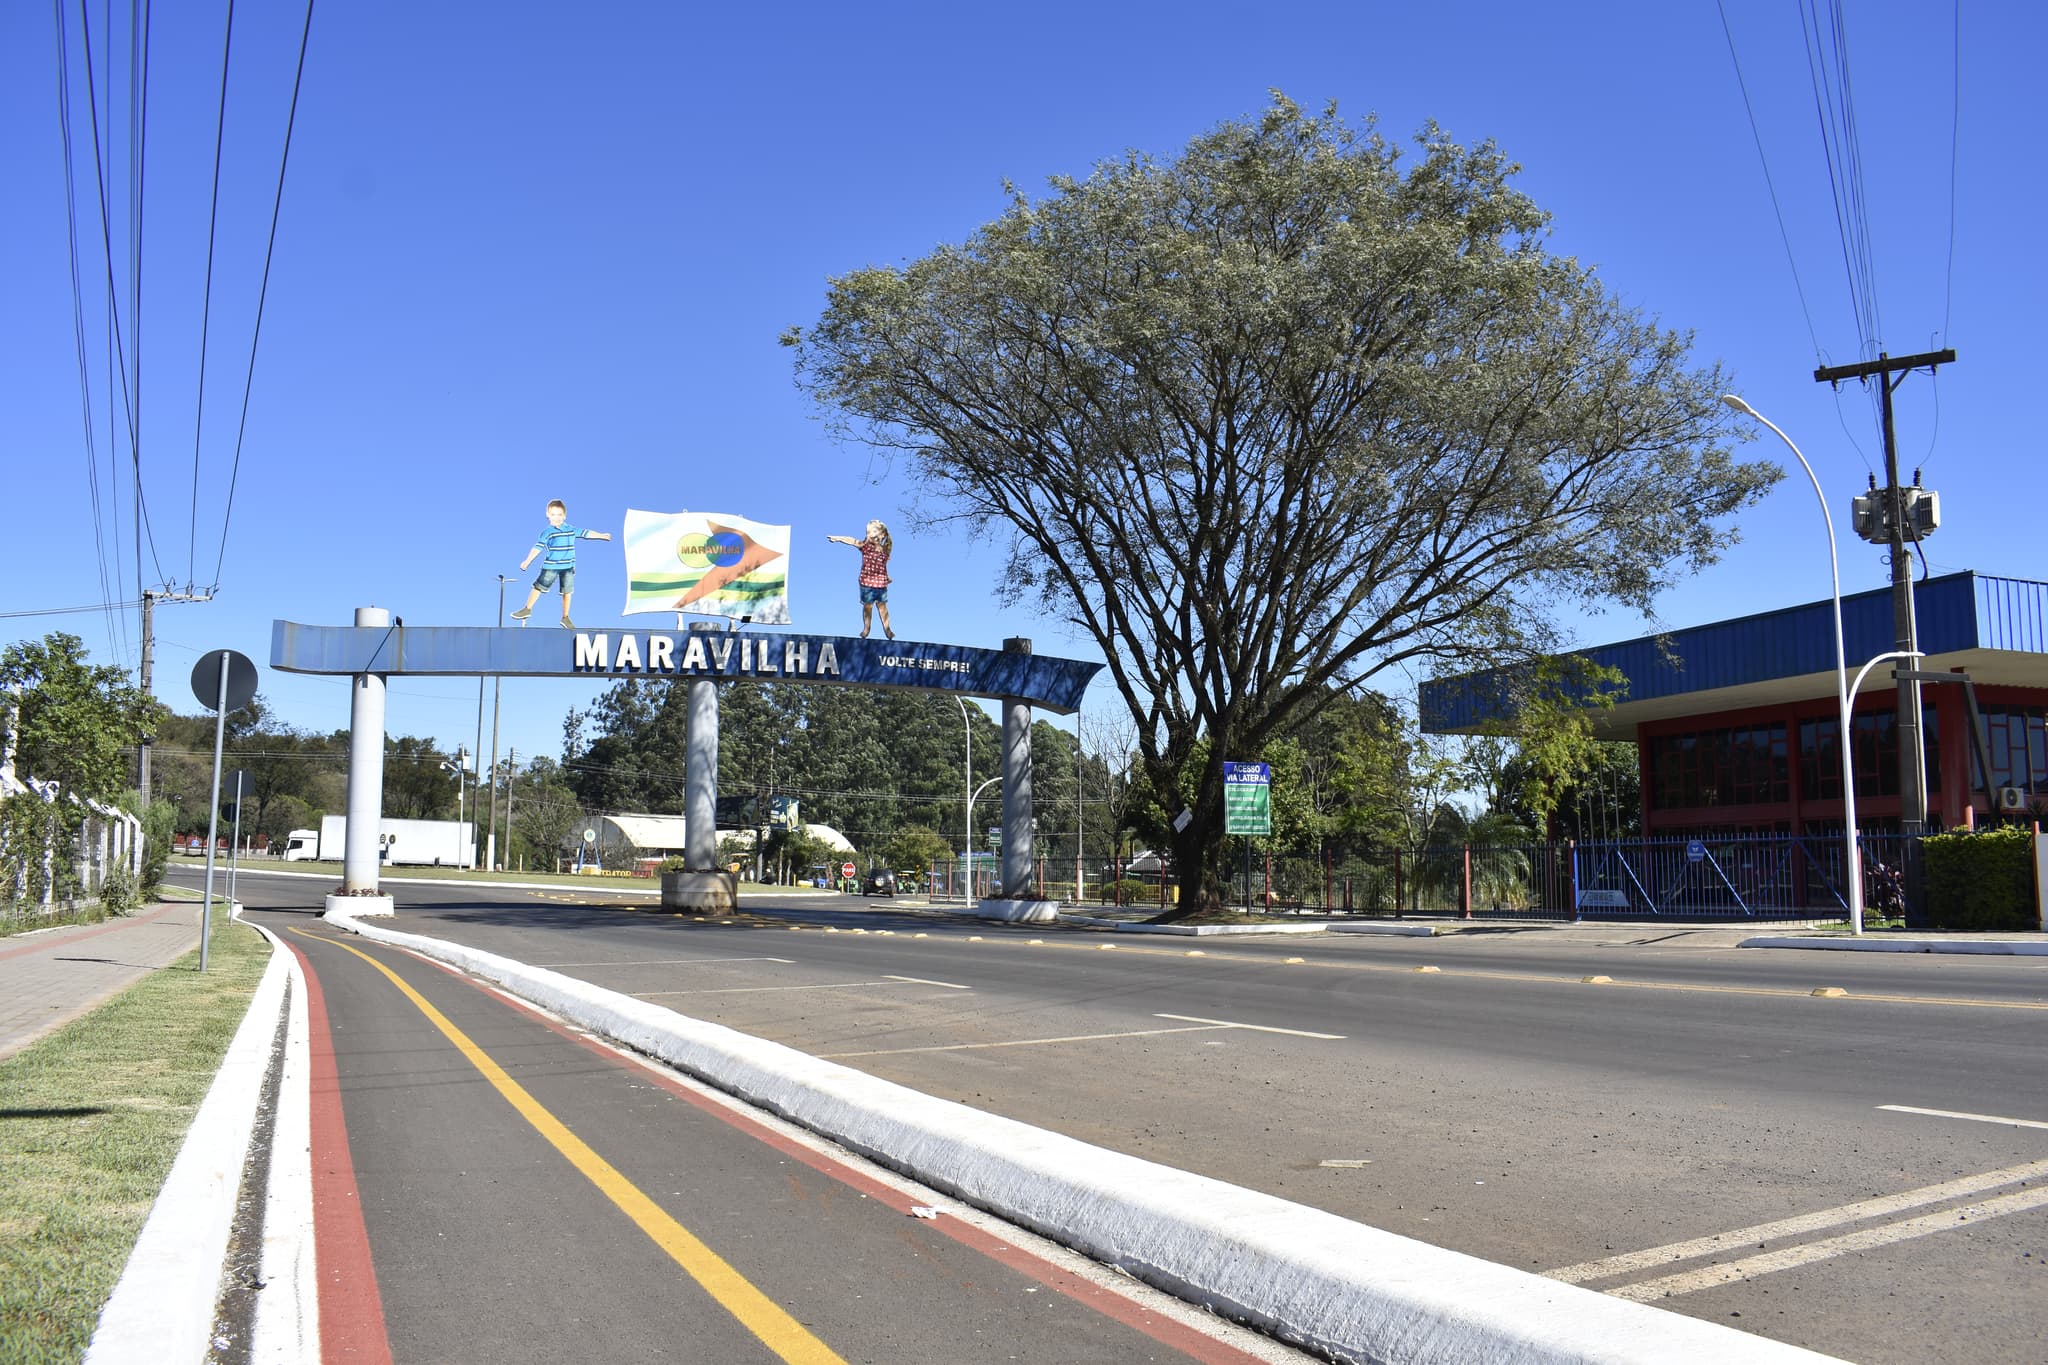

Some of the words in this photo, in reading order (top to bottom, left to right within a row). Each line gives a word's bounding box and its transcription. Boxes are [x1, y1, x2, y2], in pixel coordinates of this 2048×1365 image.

[575, 633, 840, 675] MARAVILHA
[878, 655, 915, 668] VOLTE
[918, 658, 970, 673] SEMPRE!
[1233, 765, 1261, 773] ACESSO
[1226, 774, 1238, 782] VIA
[1239, 774, 1268, 783] LATERAL
